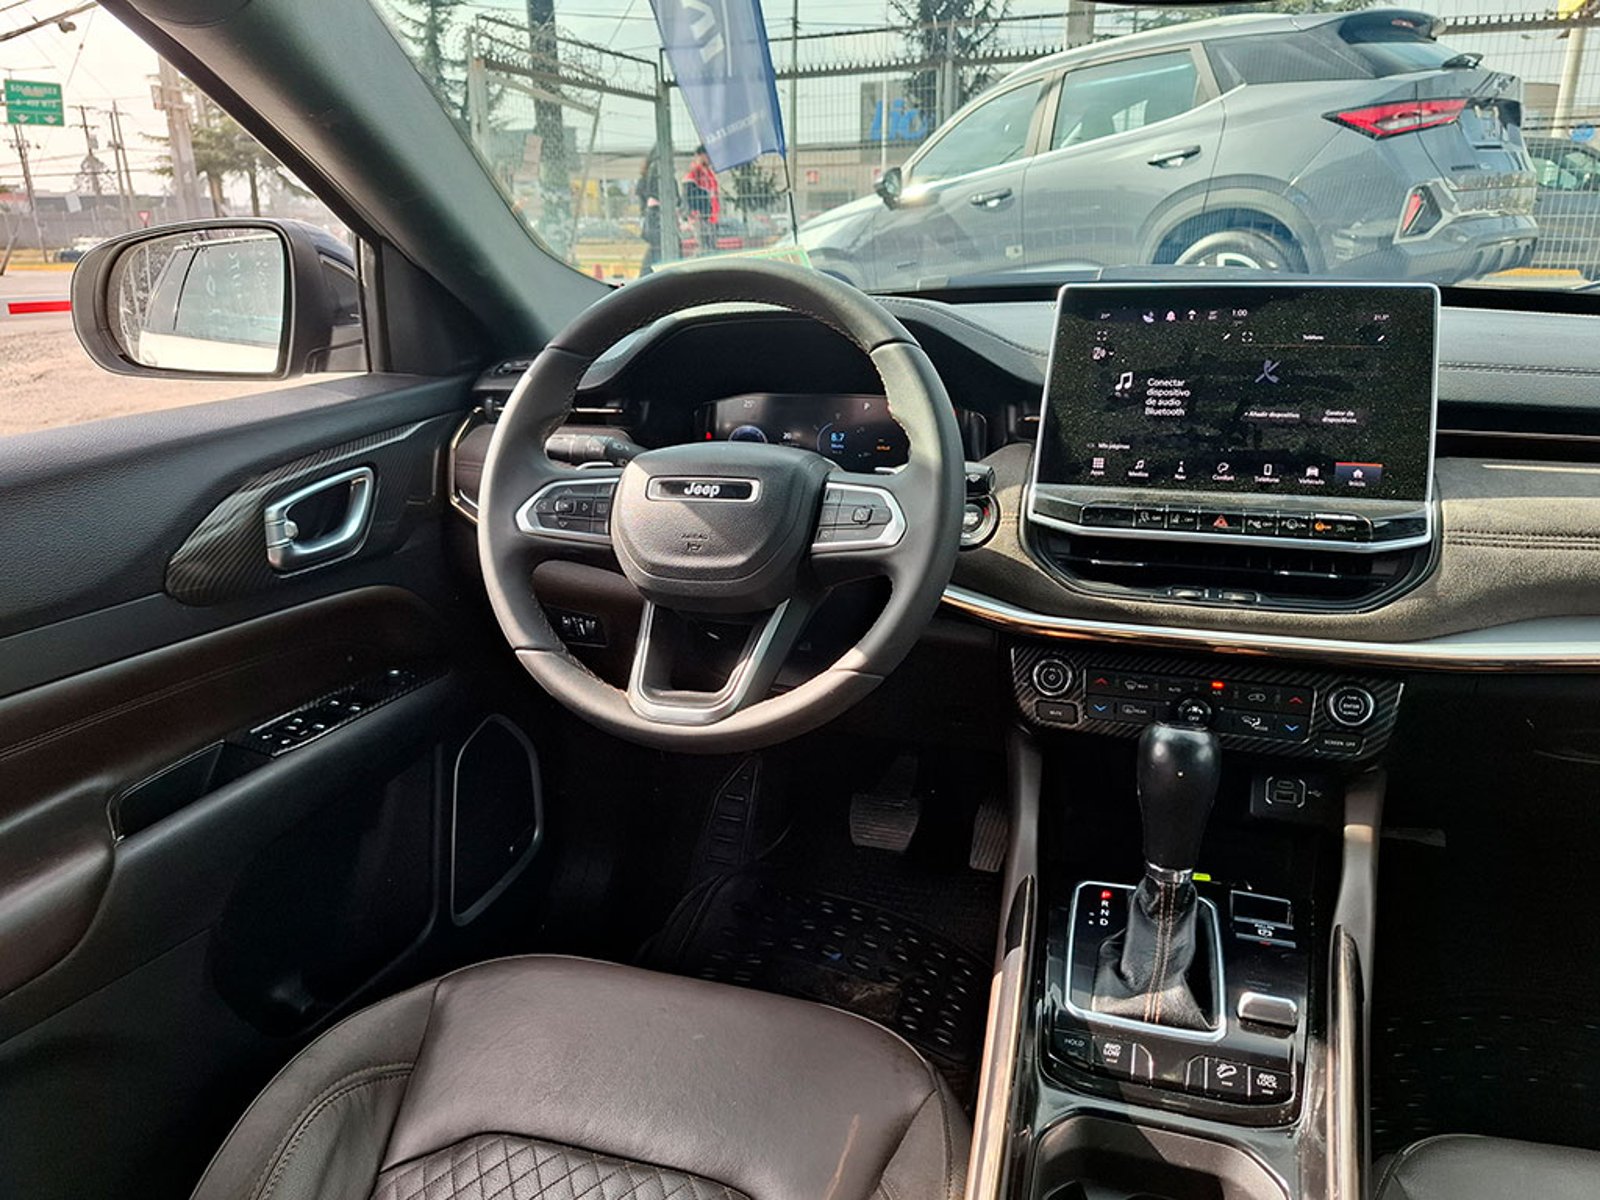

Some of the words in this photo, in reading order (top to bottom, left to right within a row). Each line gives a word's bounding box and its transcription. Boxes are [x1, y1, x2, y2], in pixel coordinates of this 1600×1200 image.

[1147, 378, 1185, 386] Conectar
[1146, 387, 1191, 397] dispositivo
[1145, 397, 1156, 406] de
[1157, 398, 1181, 406] audio
[1145, 406, 1185, 416] Bluetooth
[683, 482, 720, 498] Jeep
[1100, 909, 1110, 917] N
[1099, 918, 1109, 926] D
